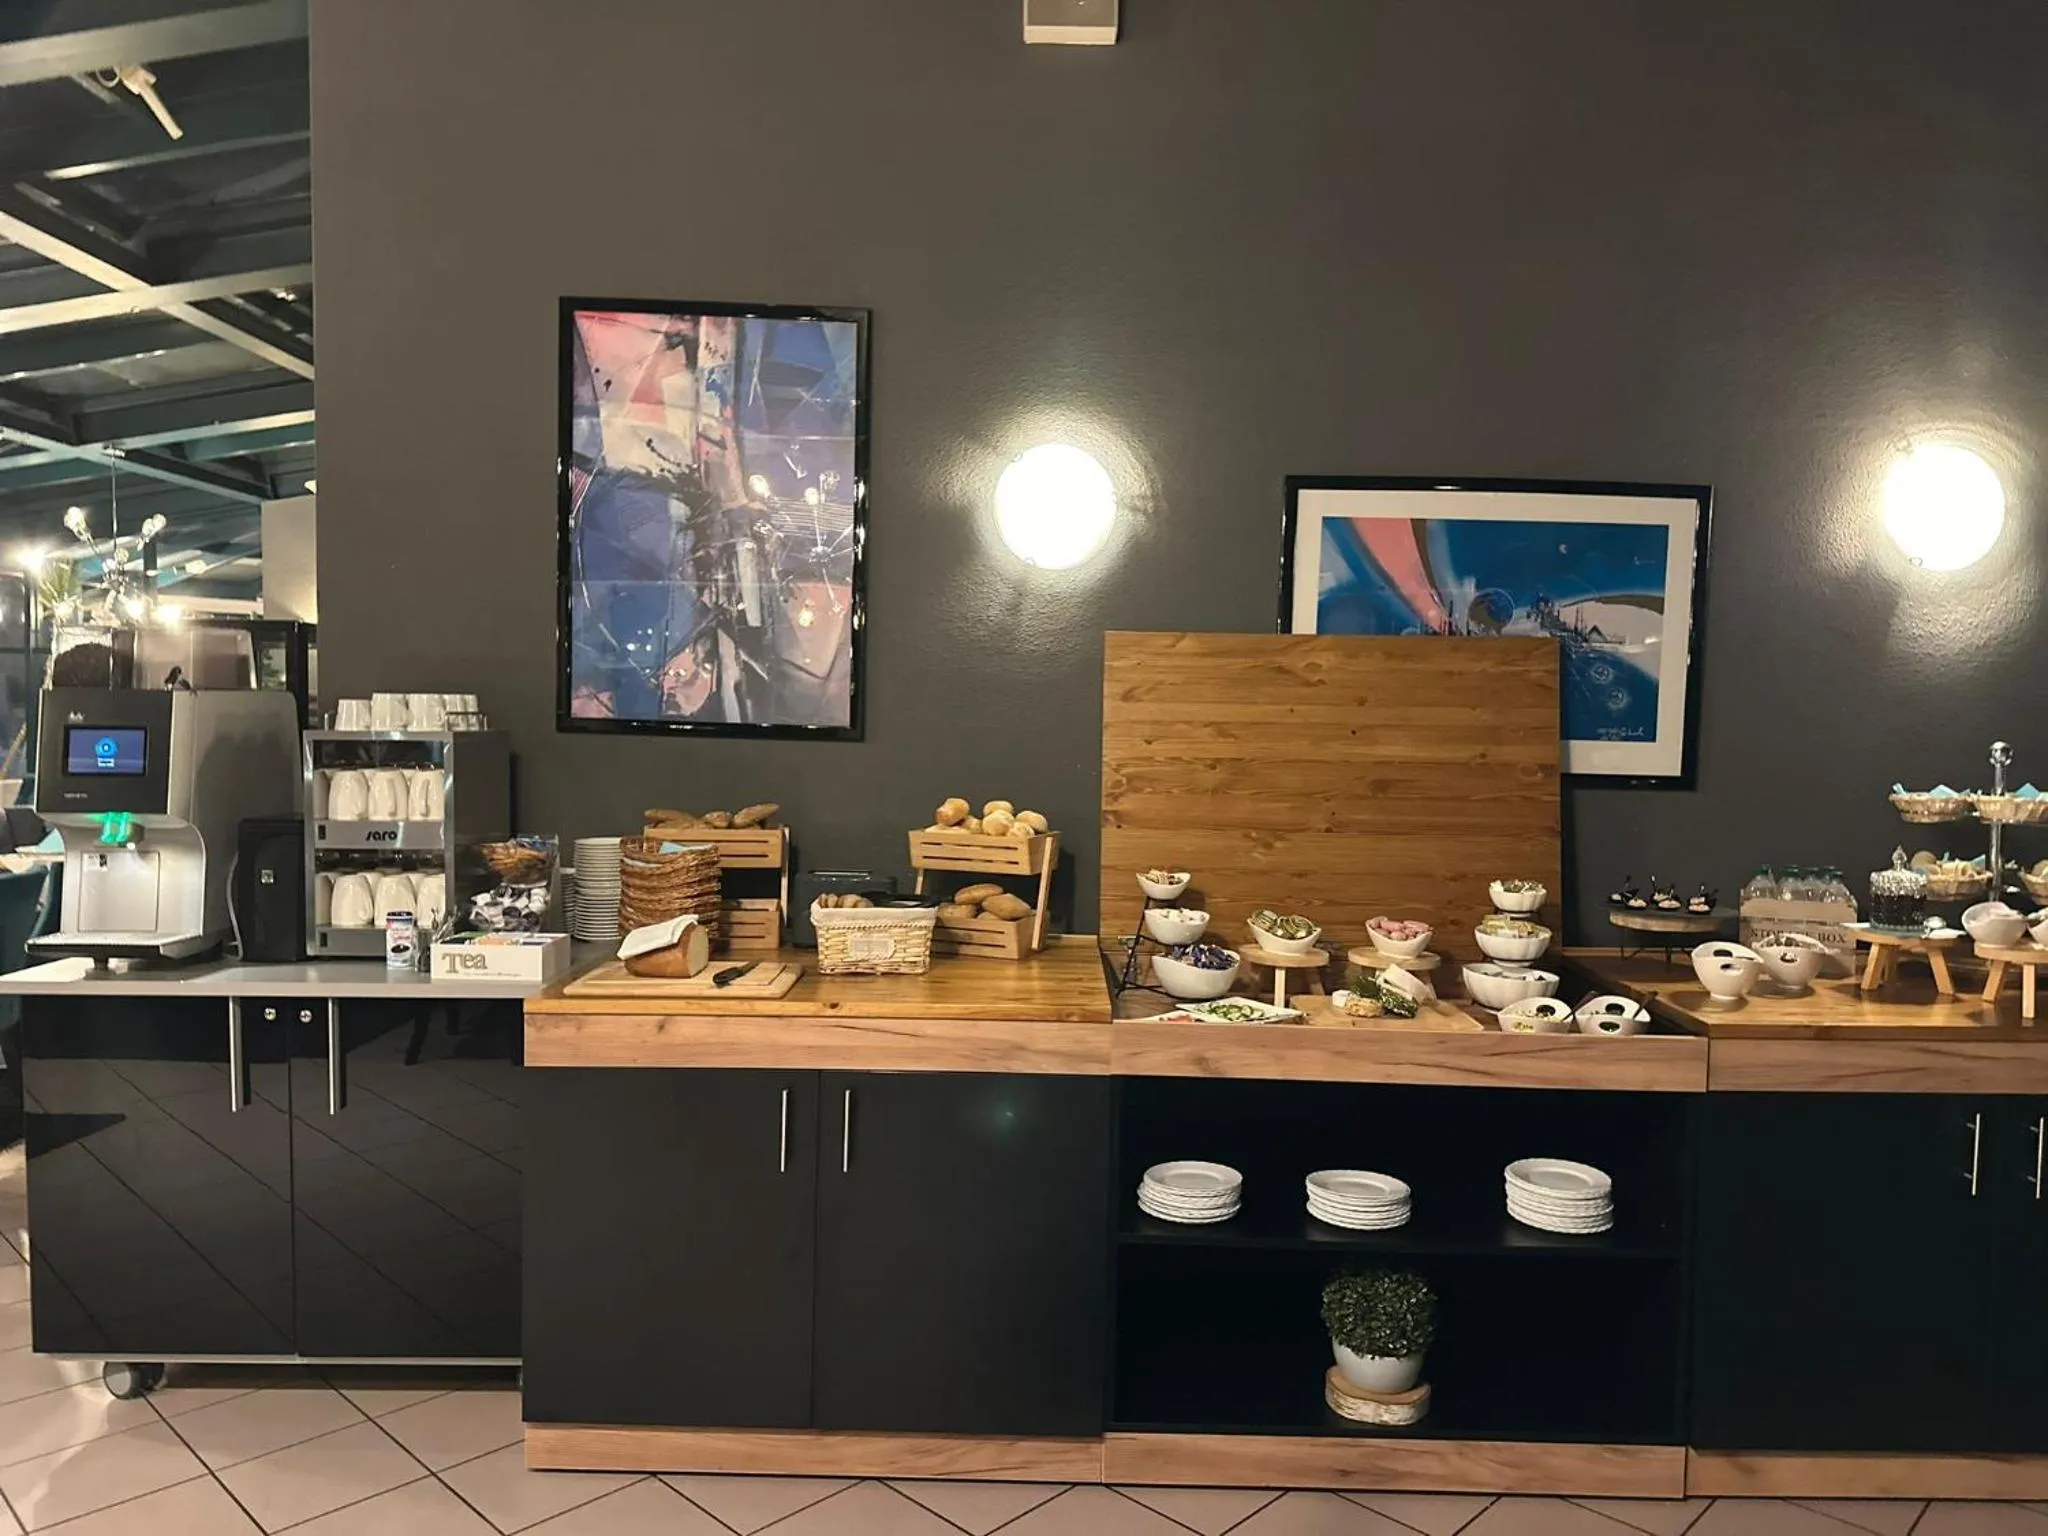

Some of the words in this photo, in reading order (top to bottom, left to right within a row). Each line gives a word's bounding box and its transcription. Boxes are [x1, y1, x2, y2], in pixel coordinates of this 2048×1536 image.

[365, 831, 398, 841] saro
[1817, 931, 1846, 943] BOX
[441, 952, 488, 974] Tea
